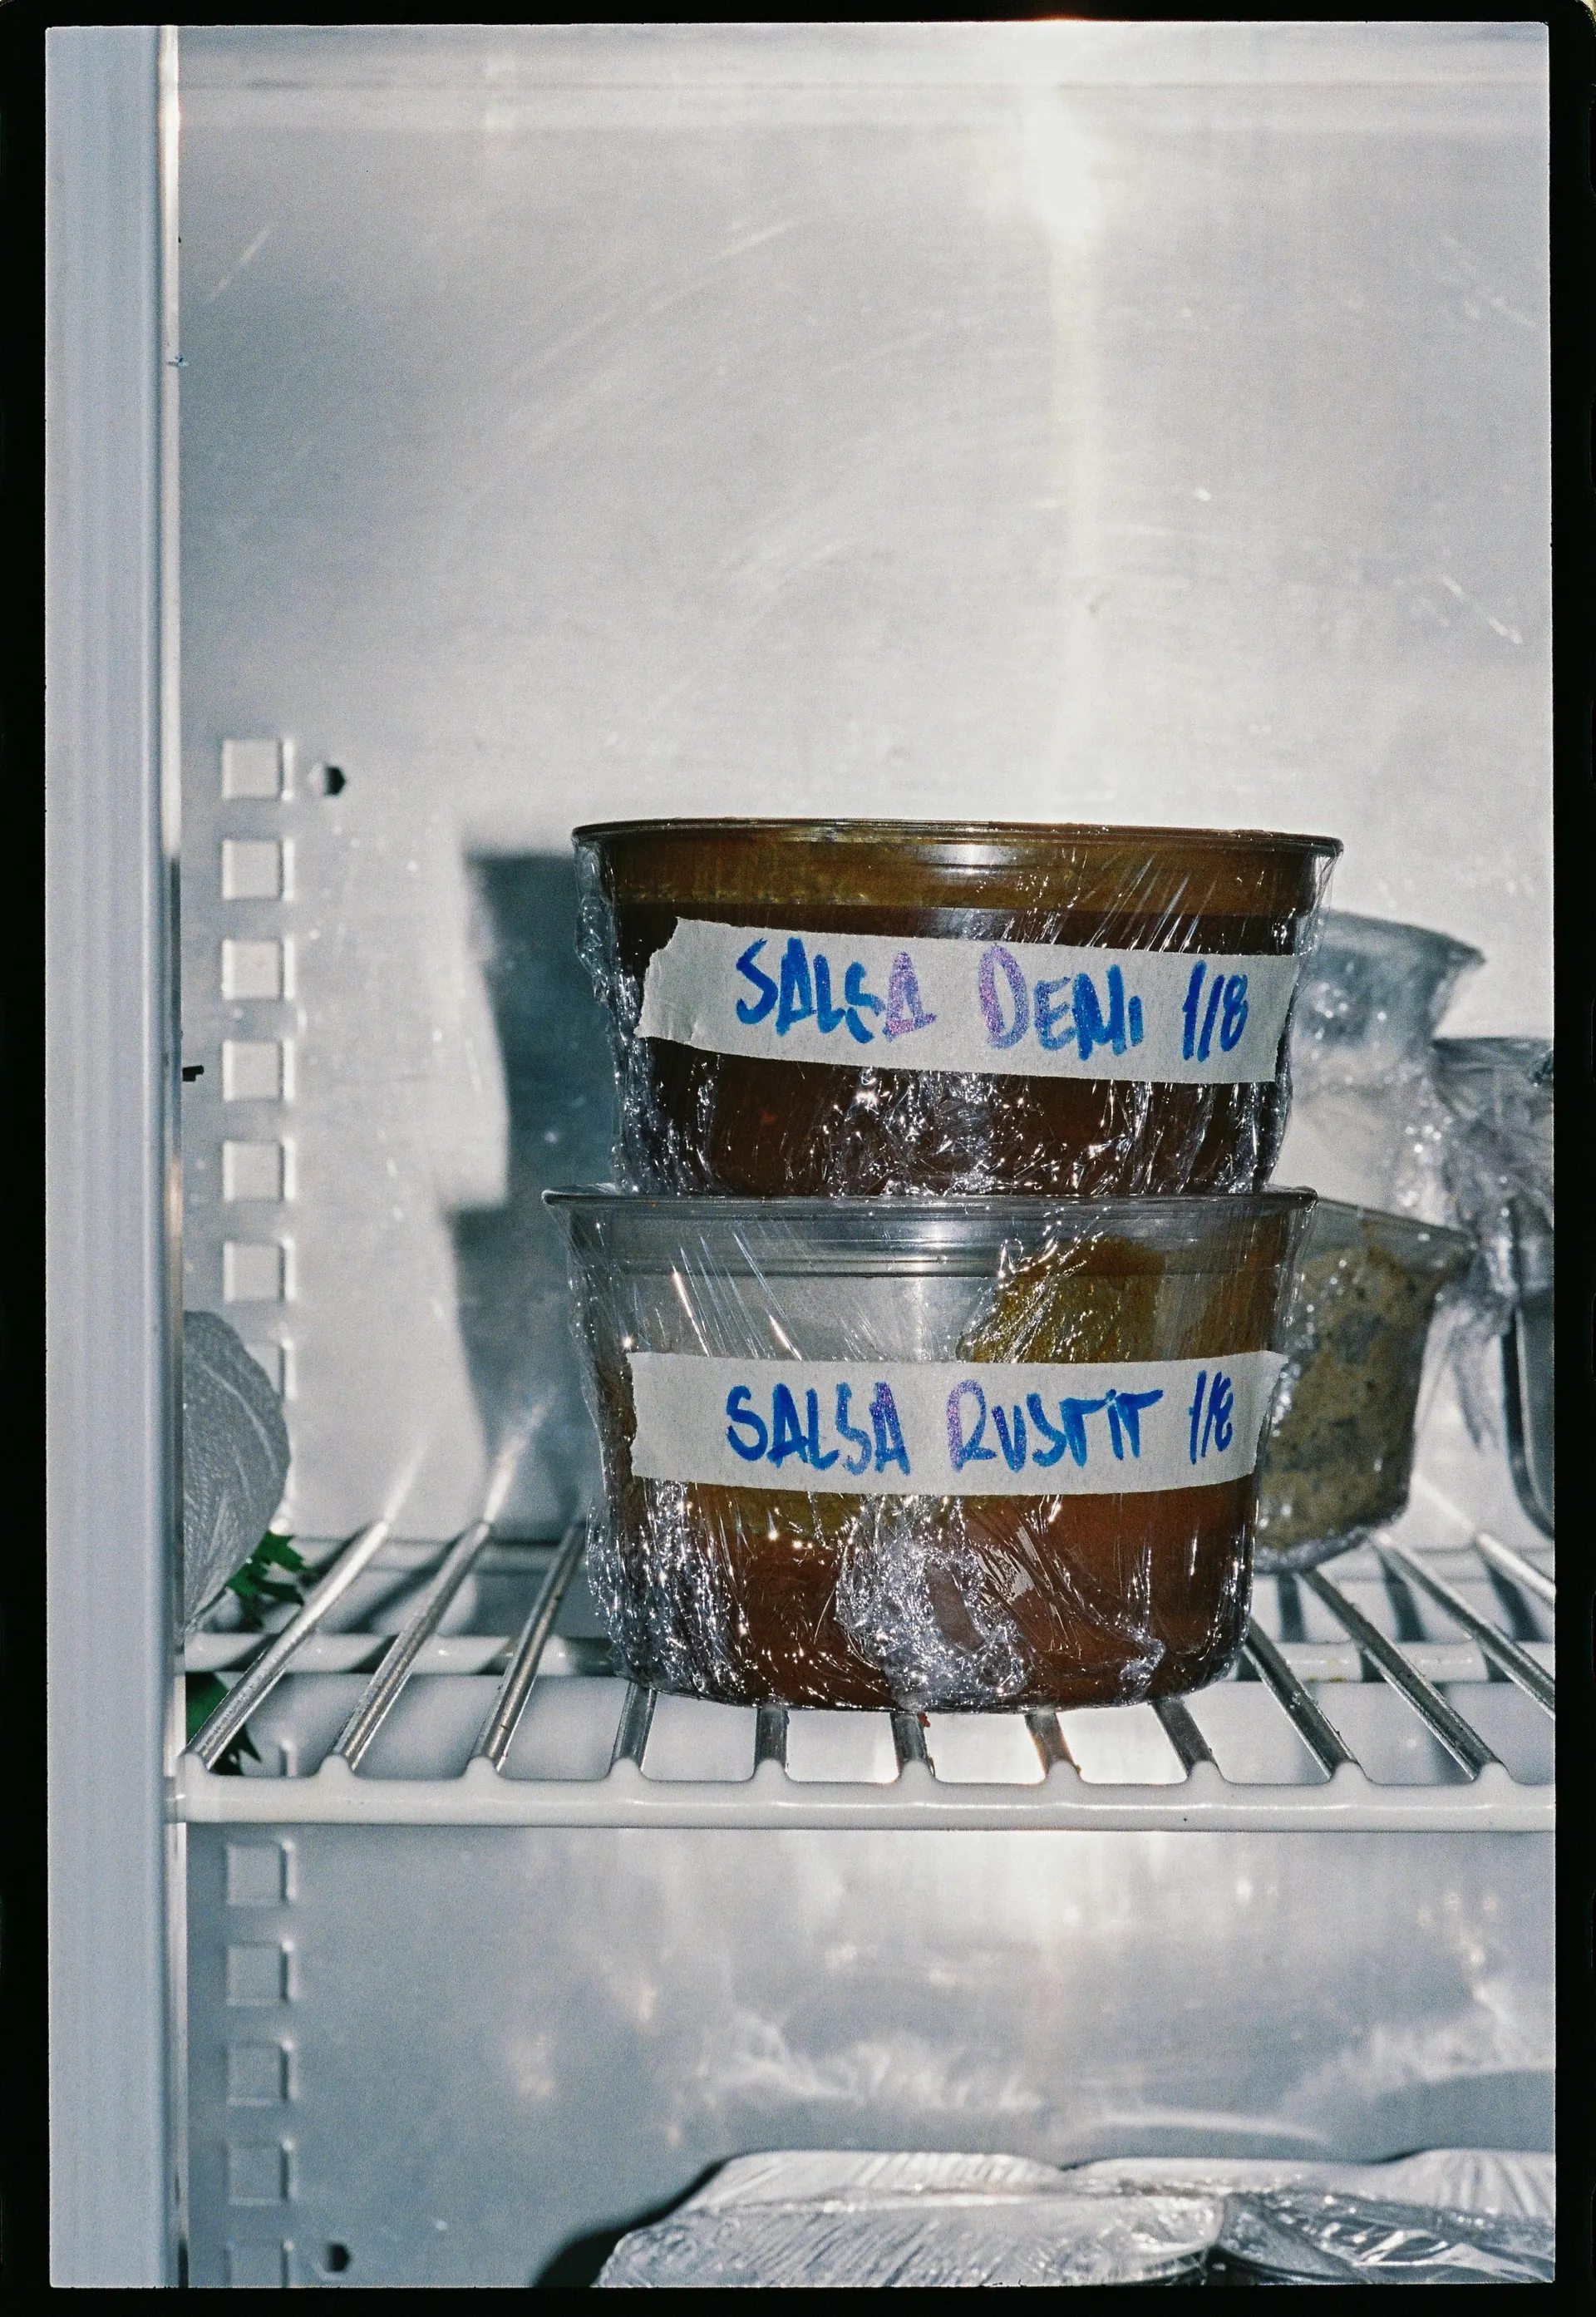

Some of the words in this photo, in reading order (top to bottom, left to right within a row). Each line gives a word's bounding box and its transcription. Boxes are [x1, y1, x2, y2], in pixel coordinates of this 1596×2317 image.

[736, 937, 937, 1045] SALSA
[1181, 959, 1249, 1063] 1/8
[726, 1381, 911, 1476] SALSA
